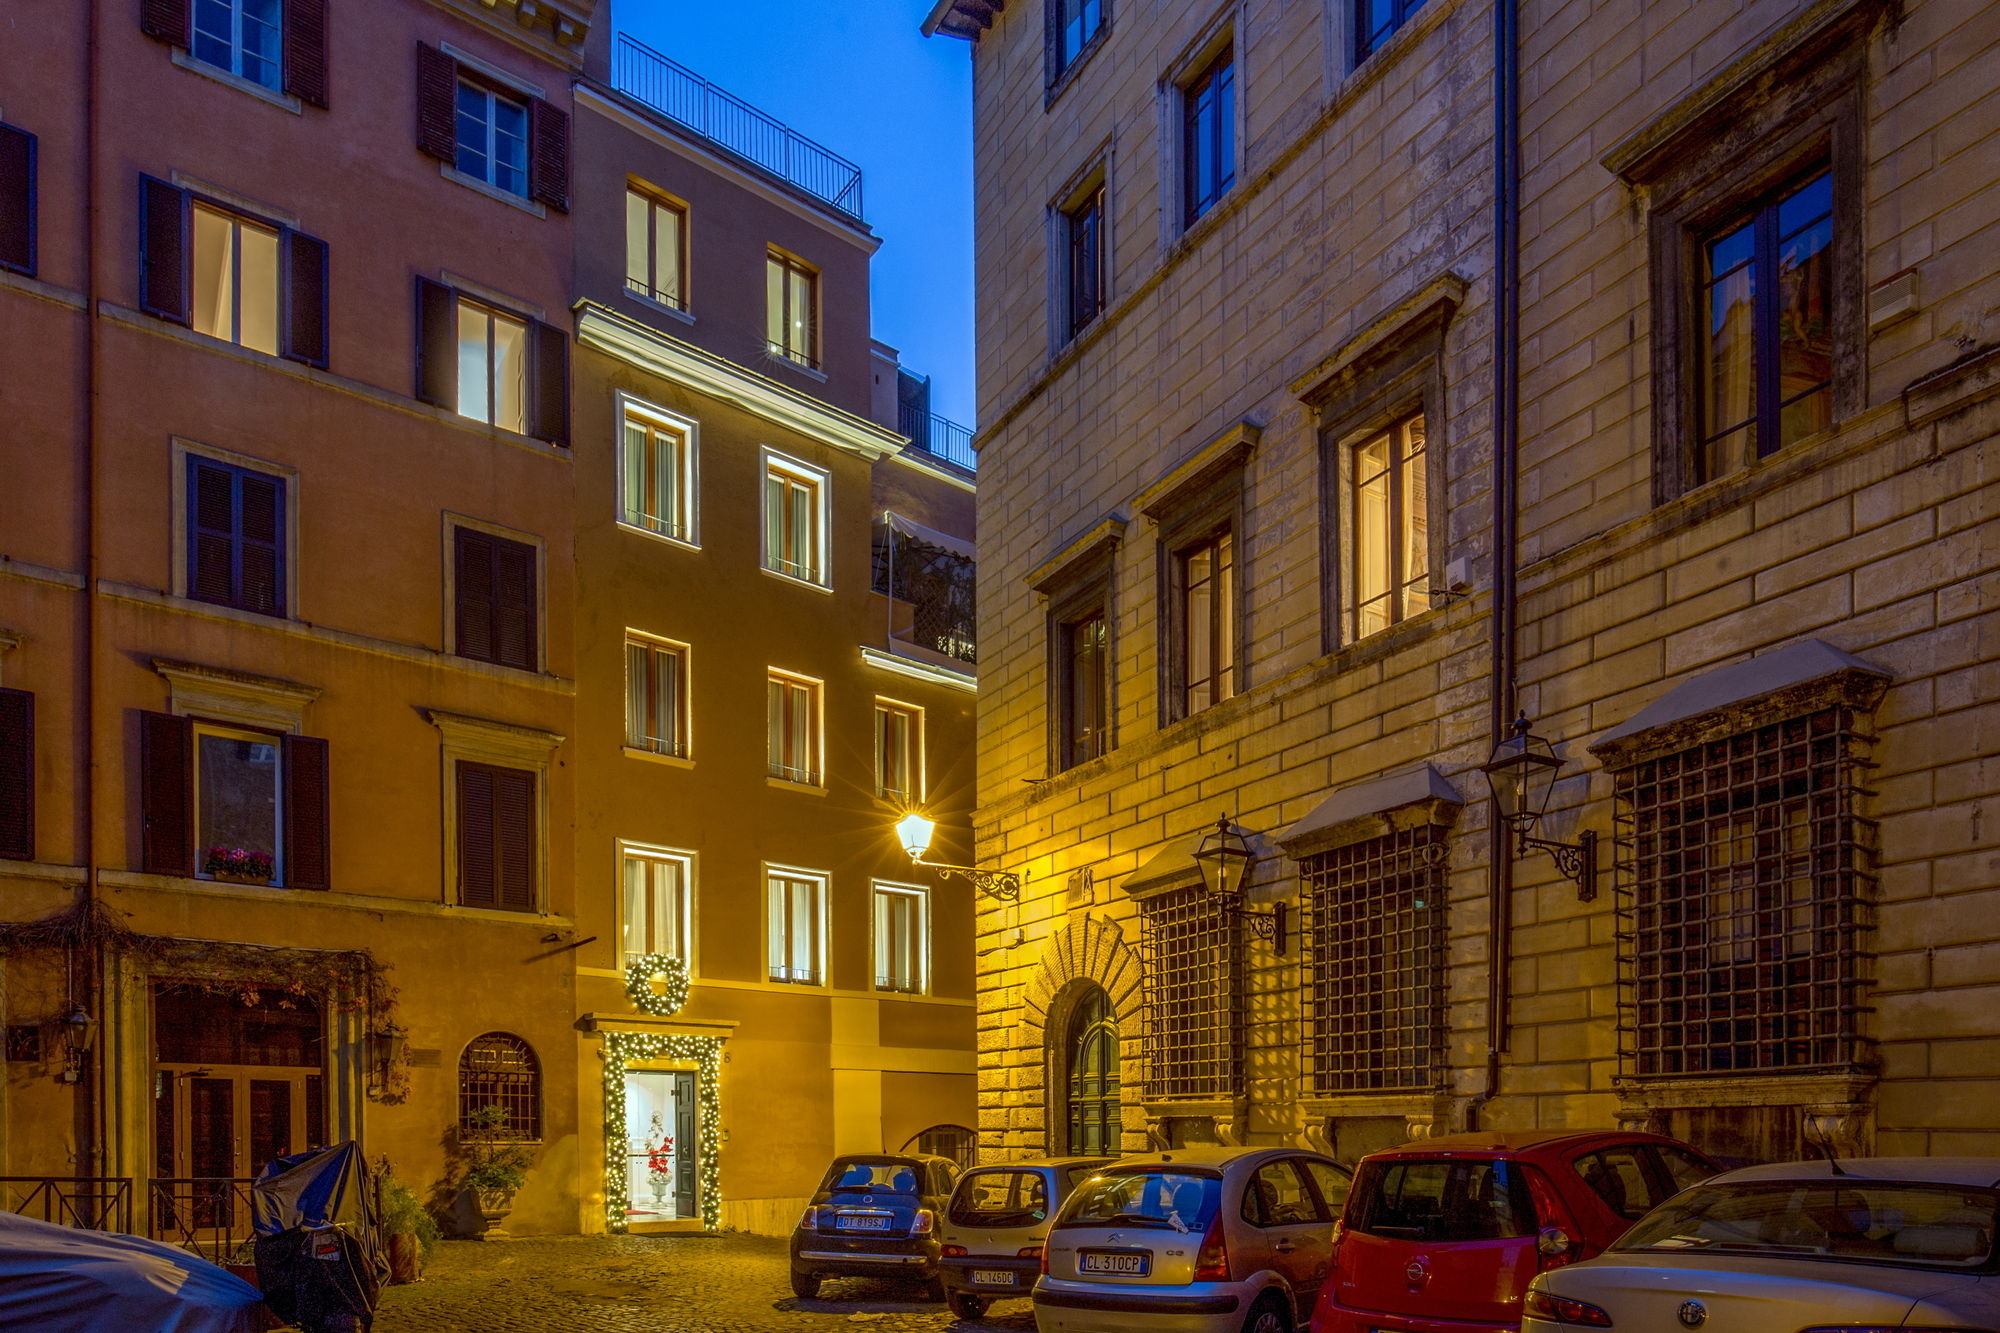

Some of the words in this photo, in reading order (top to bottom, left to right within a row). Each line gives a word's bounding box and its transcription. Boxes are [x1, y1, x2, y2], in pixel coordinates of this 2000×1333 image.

[844, 1217, 854, 1226] DT
[857, 1218, 884, 1228] 819SJ
[1086, 1255, 1101, 1270] CL
[1103, 1255, 1140, 1272] 310CP
[975, 1271, 985, 1283] CL
[987, 1271, 1013, 1284] 146DC
